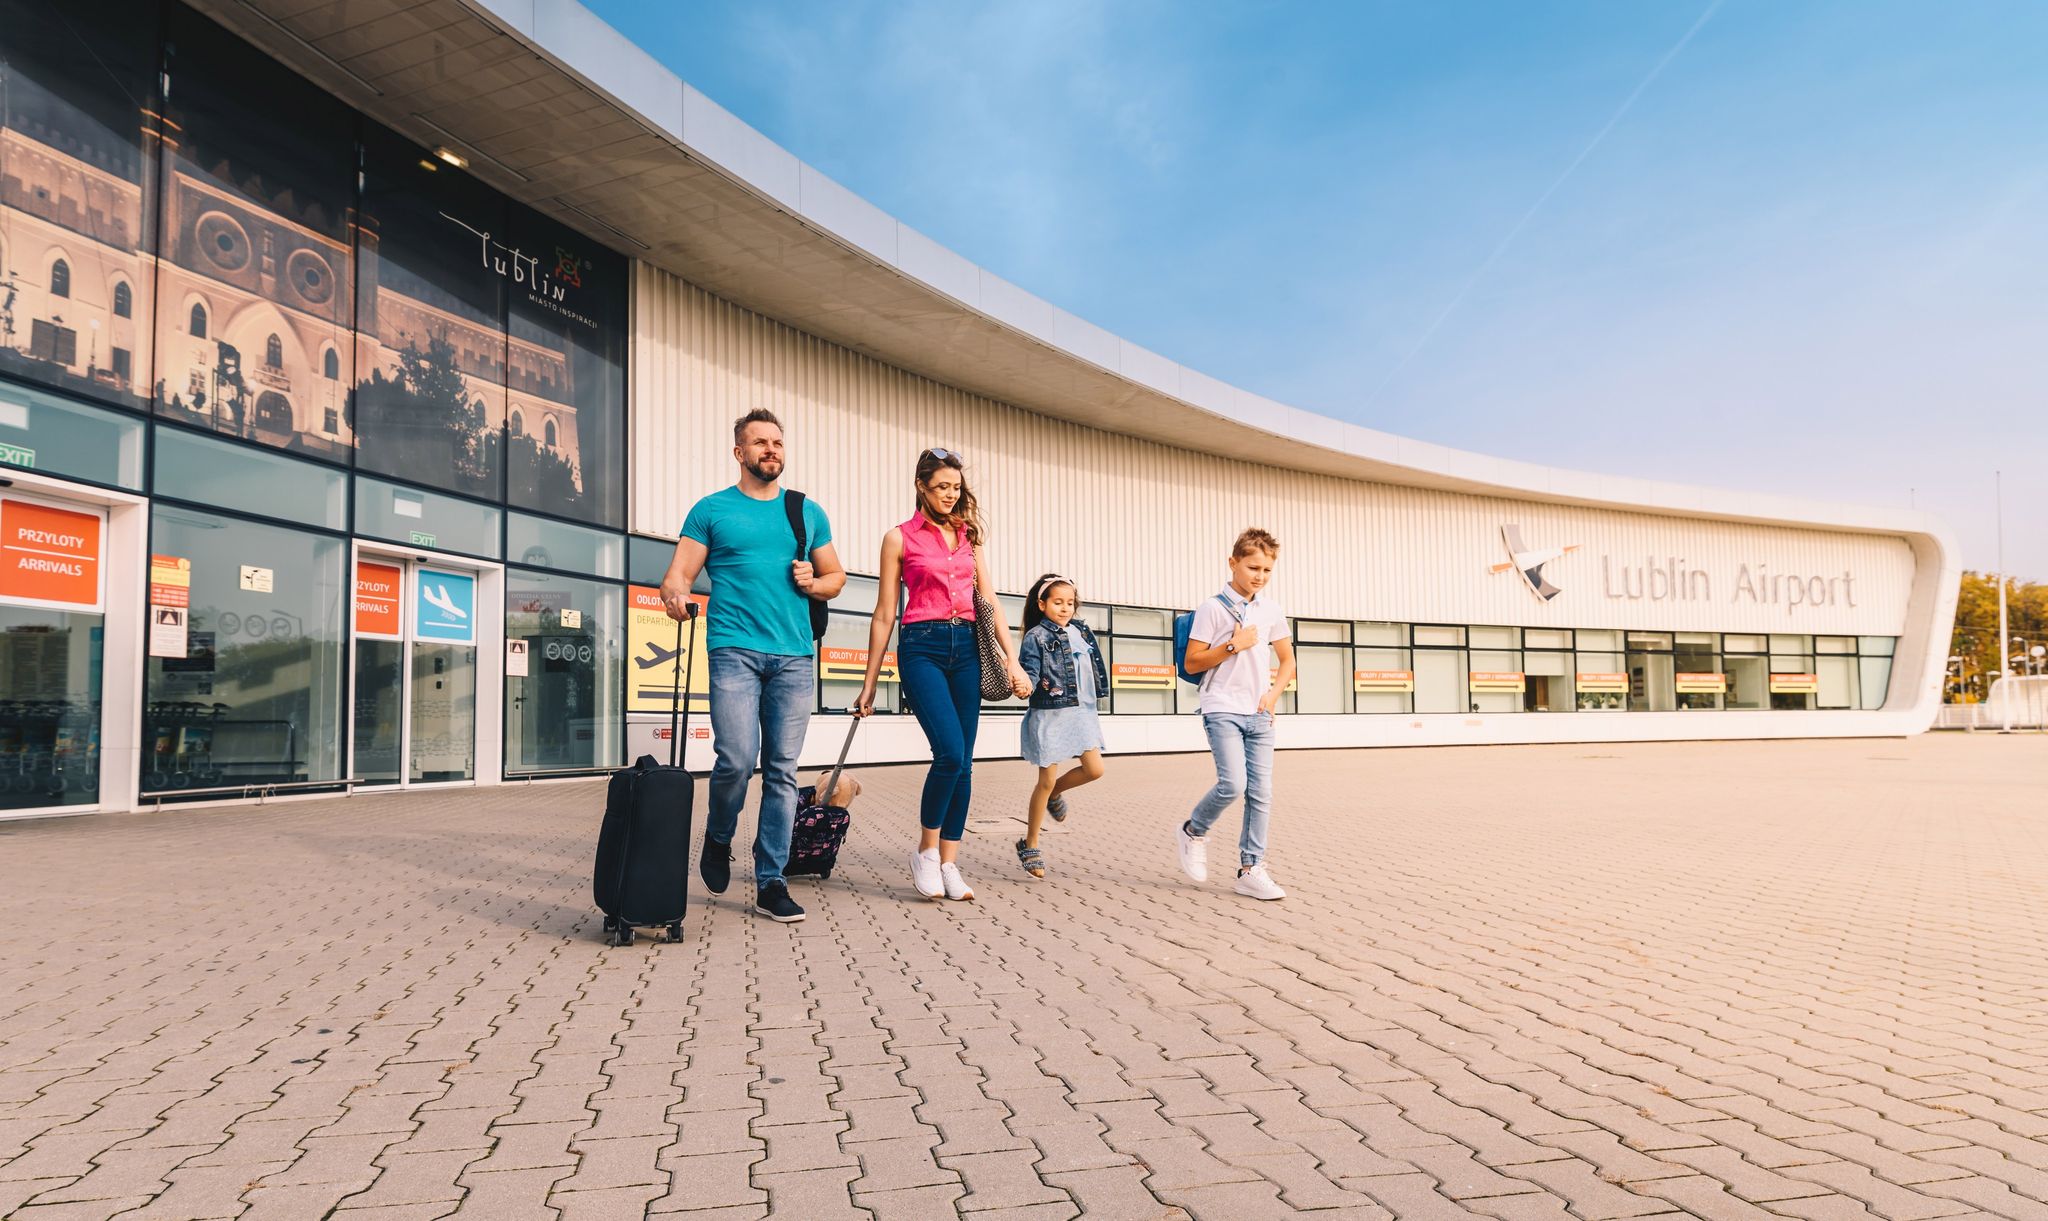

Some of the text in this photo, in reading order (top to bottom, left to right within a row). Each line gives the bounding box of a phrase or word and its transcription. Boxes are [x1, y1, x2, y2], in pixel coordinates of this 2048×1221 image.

[529, 294, 598, 329] MIASTO INSPIRACJI
[18, 528, 84, 548] PRZYLOTY
[412, 534, 435, 547] EXIT
[18, 558, 83, 576] ARRIVALS
[1602, 555, 1857, 616] Lublin Airport
[355, 602, 389, 614] RRIVALS
[829, 651, 853, 660] ODLOTY
